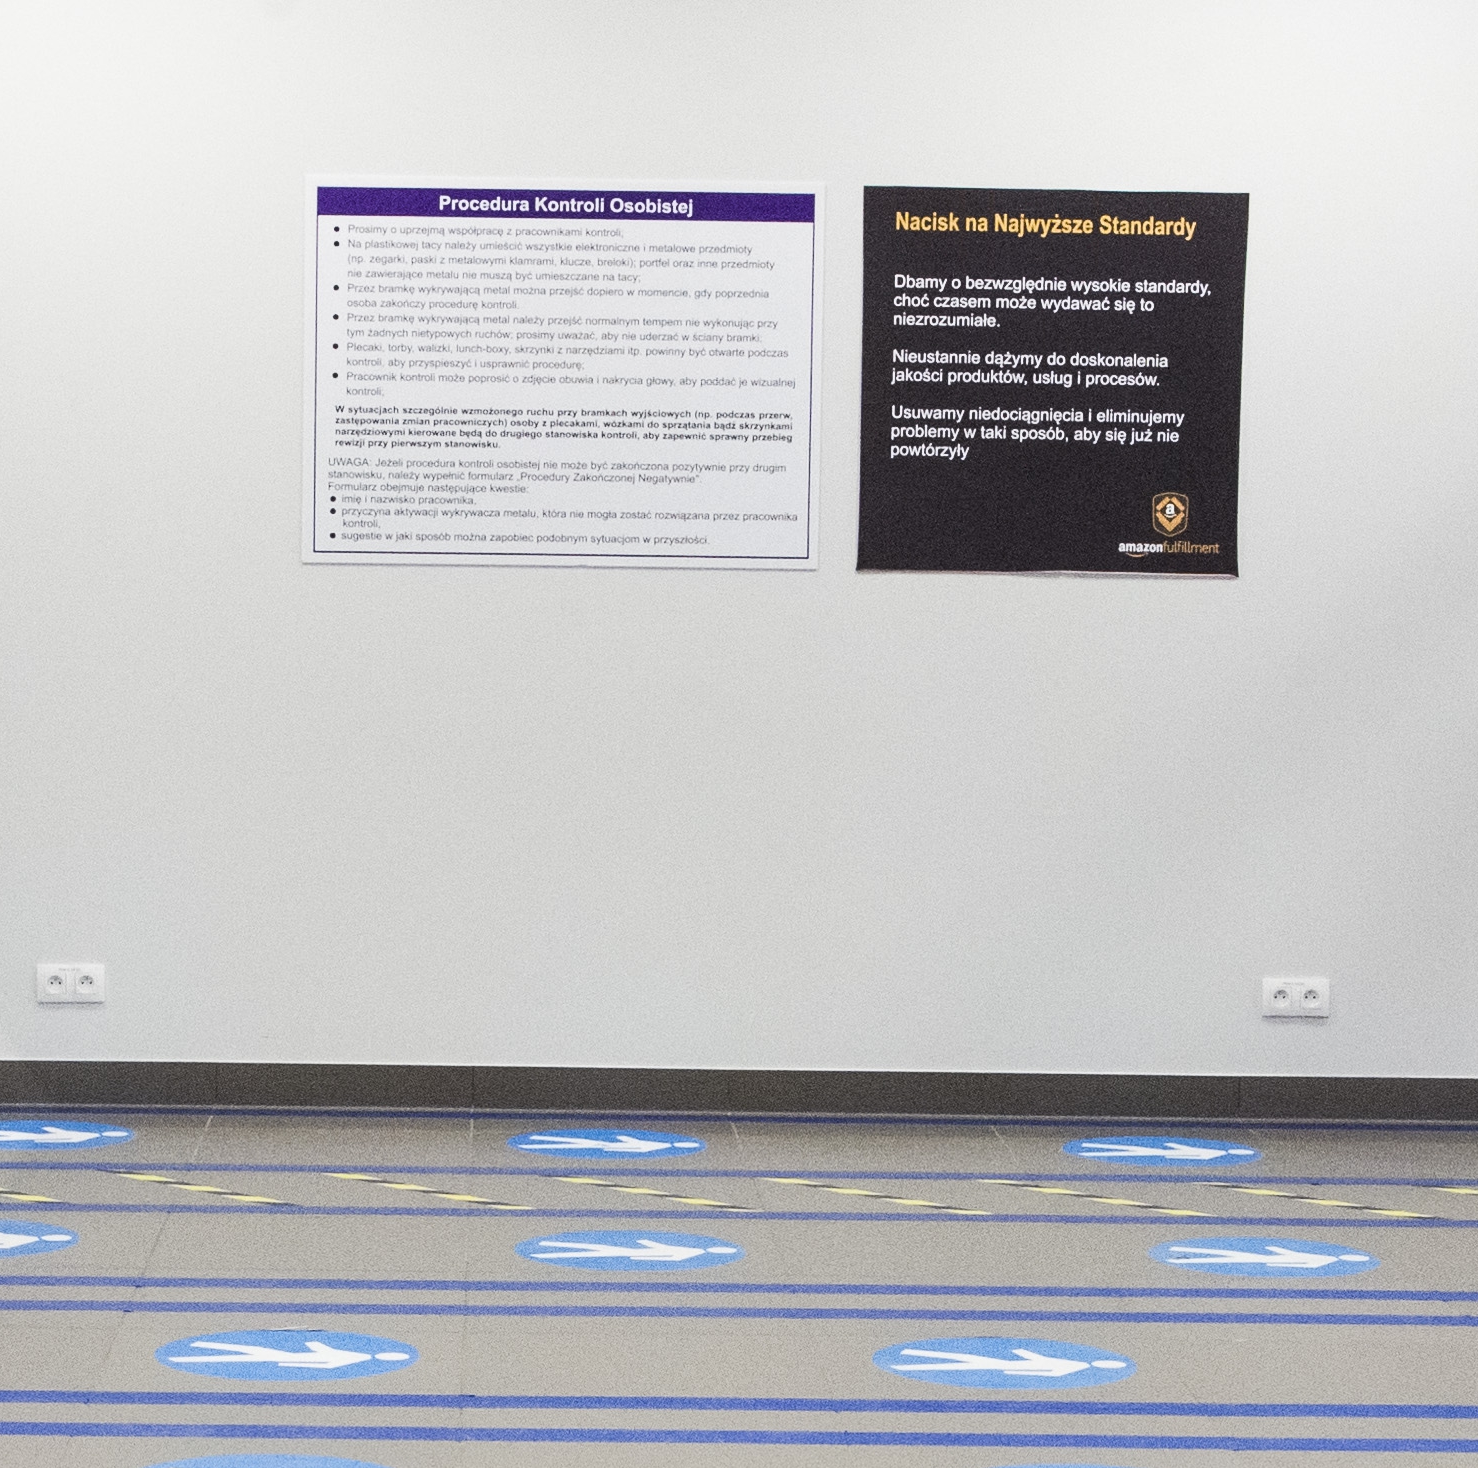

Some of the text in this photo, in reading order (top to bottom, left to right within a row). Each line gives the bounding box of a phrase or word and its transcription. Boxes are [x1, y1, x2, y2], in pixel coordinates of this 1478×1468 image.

[439, 195, 692, 217] Procedura Kontroli Osobistej
[895, 210, 1196, 240] Nacisk na Najwyższe Standardy
[894, 273, 1211, 296] Dbamy o bezwzględnie wysokie standardy,
[893, 291, 1154, 313] choć czasem może wydawać się to
[893, 310, 1000, 326] niezrozumiałe.
[892, 347, 1168, 367] Nieustannie dążymy do doskonalenia
[891, 366, 1159, 388] jakości produktów, usług i procesów.
[334, 404, 344, 412] W
[347, 405, 399, 415] sytuacjach
[402, 405, 457, 416] szczególnie
[461, 406, 523, 417] wzmożonego
[526, 407, 554, 415] ruchu
[557, 409, 577, 417] przy
[580, 408, 627, 416] bramkach
[630, 409, 691, 419] wyjściowych
[716, 410, 755, 420] podczas
[891, 403, 1184, 426] Usuwamy niedociągnięcia i eliminujemy
[335, 415, 399, 426] zastępowania
[402, 416, 430, 424] zmian
[509, 418, 539, 428] osoby
[602, 419, 644, 427] wózkami
[661, 420, 711, 430] sprzątania
[713, 421, 736, 431] bądź
[738, 421, 793, 431] skrzynkami
[890, 422, 1179, 444] problemy w taki sposób, aby się już nie
[334, 427, 405, 437] narzędziowymi
[408, 428, 456, 436] kierowane
[459, 428, 482, 438] będą
[499, 429, 542, 439] drugiego
[545, 430, 598, 438] stanowiska
[642, 431, 660, 441] aby
[662, 431, 706, 441] zapewnić
[709, 434, 749, 442] sprawny
[751, 432, 792, 442] przebieg
[334, 438, 365, 448] rewizji
[367, 440, 388, 448] przy
[390, 439, 441, 449] pierwszym
[890, 441, 969, 459] powtórzyły
